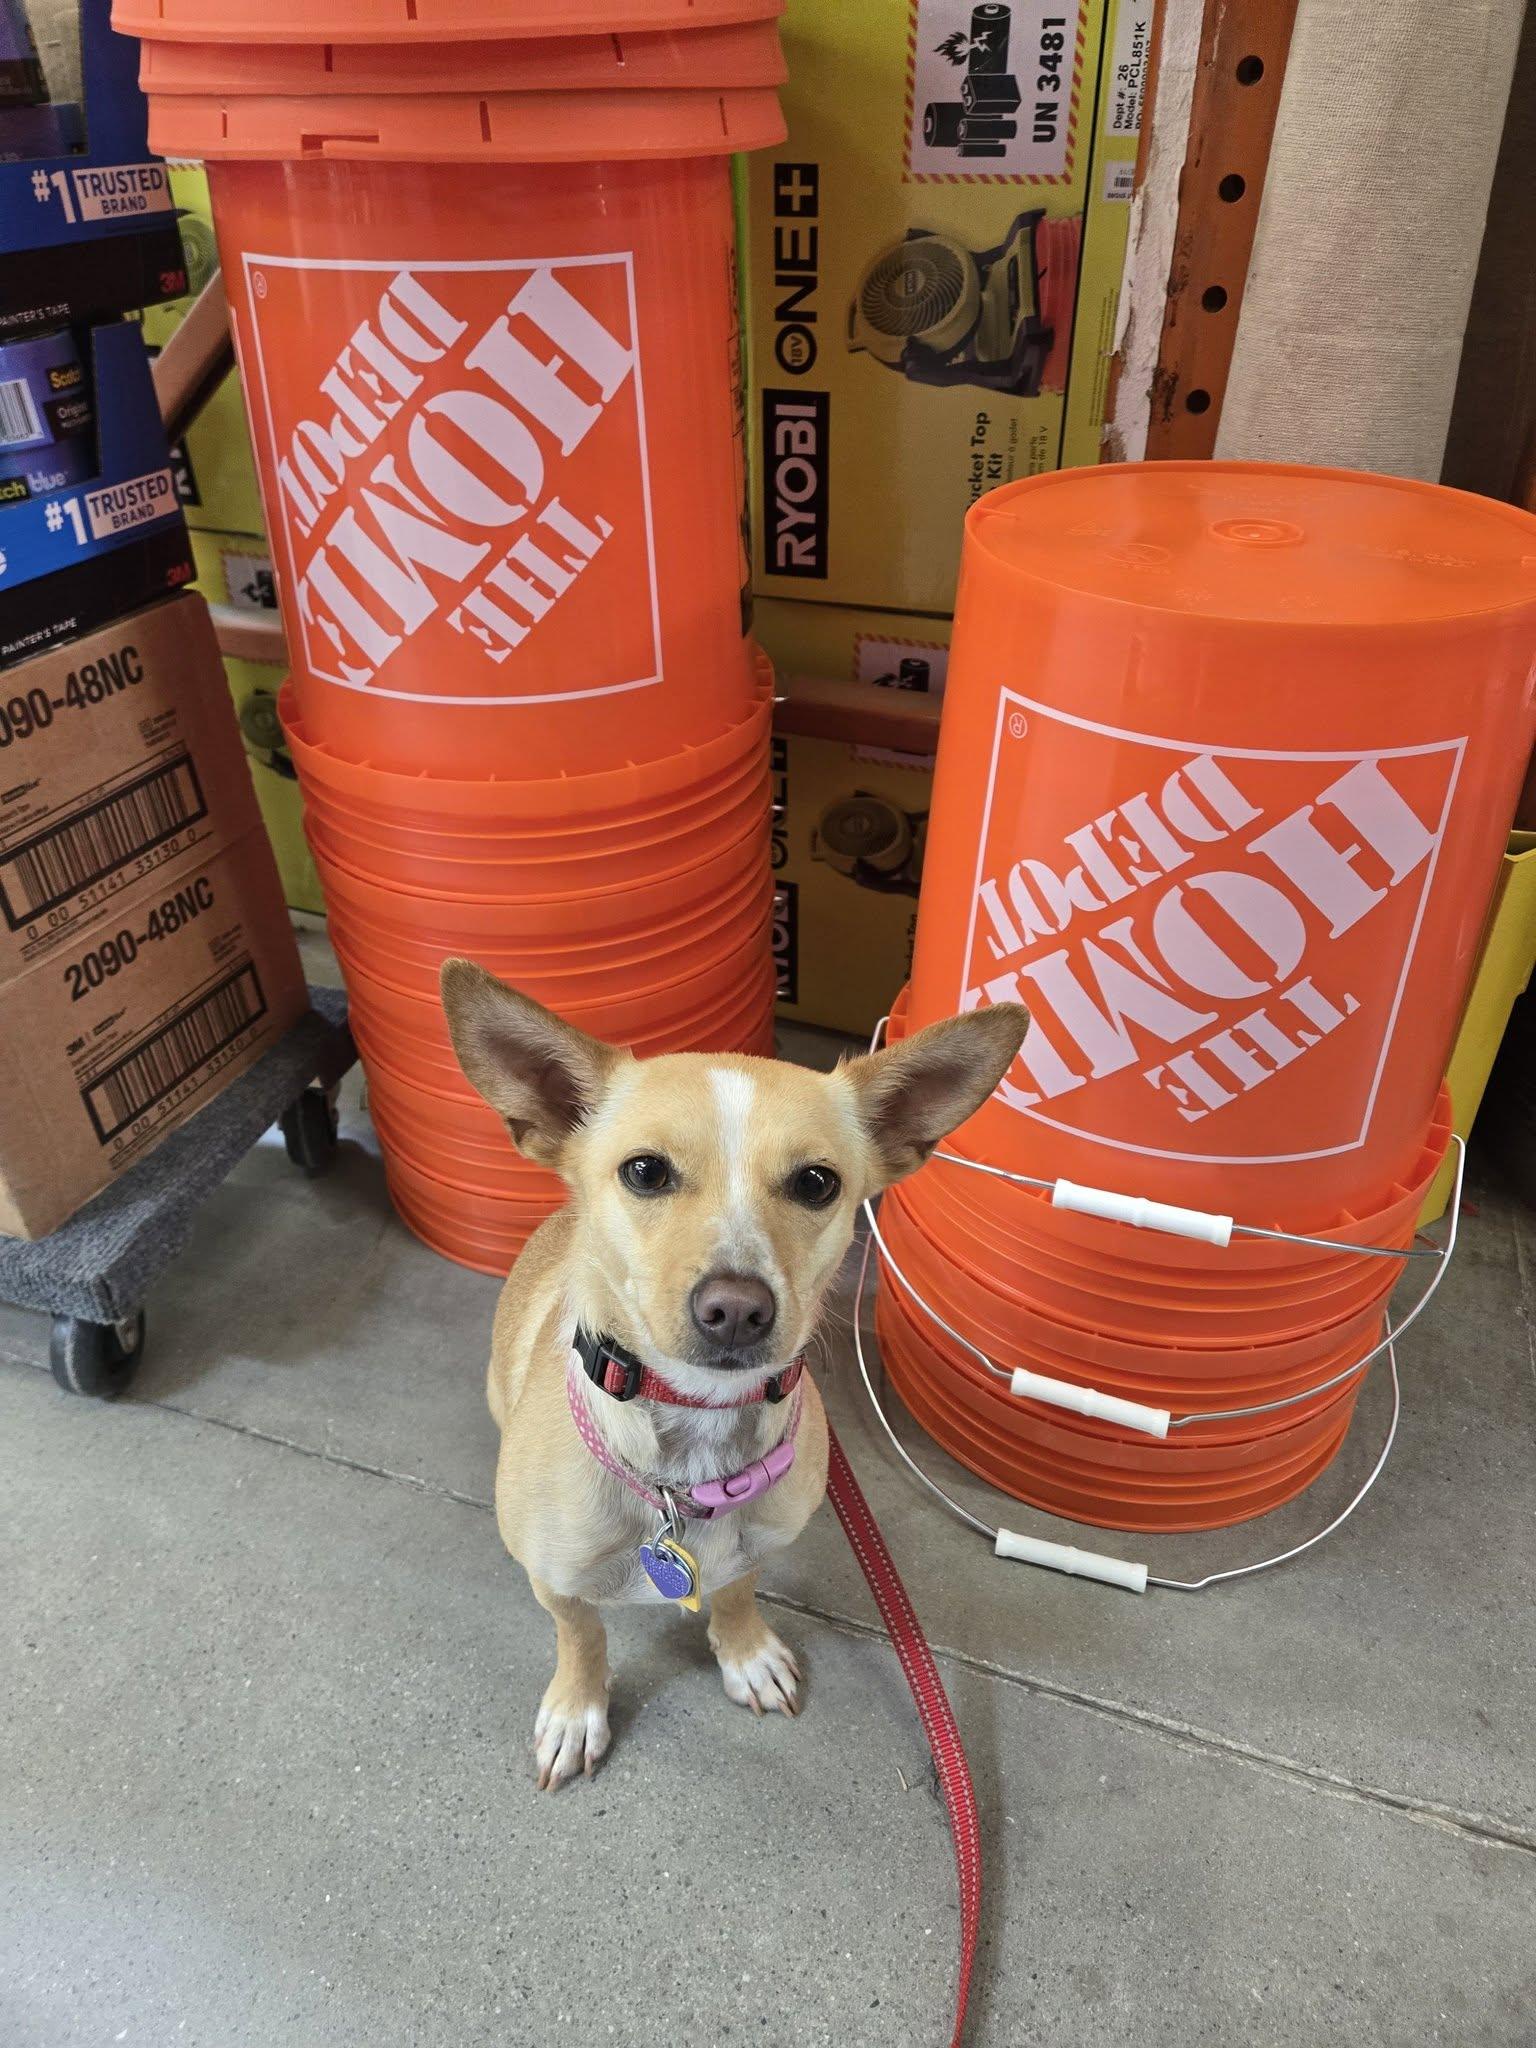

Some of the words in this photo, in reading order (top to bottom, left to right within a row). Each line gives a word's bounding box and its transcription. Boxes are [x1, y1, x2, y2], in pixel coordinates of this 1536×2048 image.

[1037, 18, 1067, 93] 3481
[1118, 64, 1129, 81] 26
[1128, 21, 1147, 88] PCL851K
[1032, 102, 1060, 143] UN
[1112, 103, 1126, 129] Dept
[1124, 92, 1136, 130] Model:
[31, 168, 76, 224] #1
[76, 167, 164, 199] TRUSTED
[101, 195, 148, 215] BRAND
[278, 270, 469, 539] DEPOT
[969, 411, 990, 447] Top
[297, 267, 635, 687] HOME
[775, 404, 818, 568] RYOBI
[968, 453, 985, 503] ucket
[986, 452, 1003, 479] Kit
[45, 496, 88, 546] #1
[89, 475, 169, 519] TRUSTED
[111, 503, 155, 529] BRAND
[446, 496, 614, 664] THE
[53, 616, 78, 634] TAPE
[0, 645, 144, 749] 090-48NC
[979, 753, 1264, 961] DEPOT
[63, 876, 215, 1002] 2090-48NC
[1142, 975, 1361, 1123] THE
